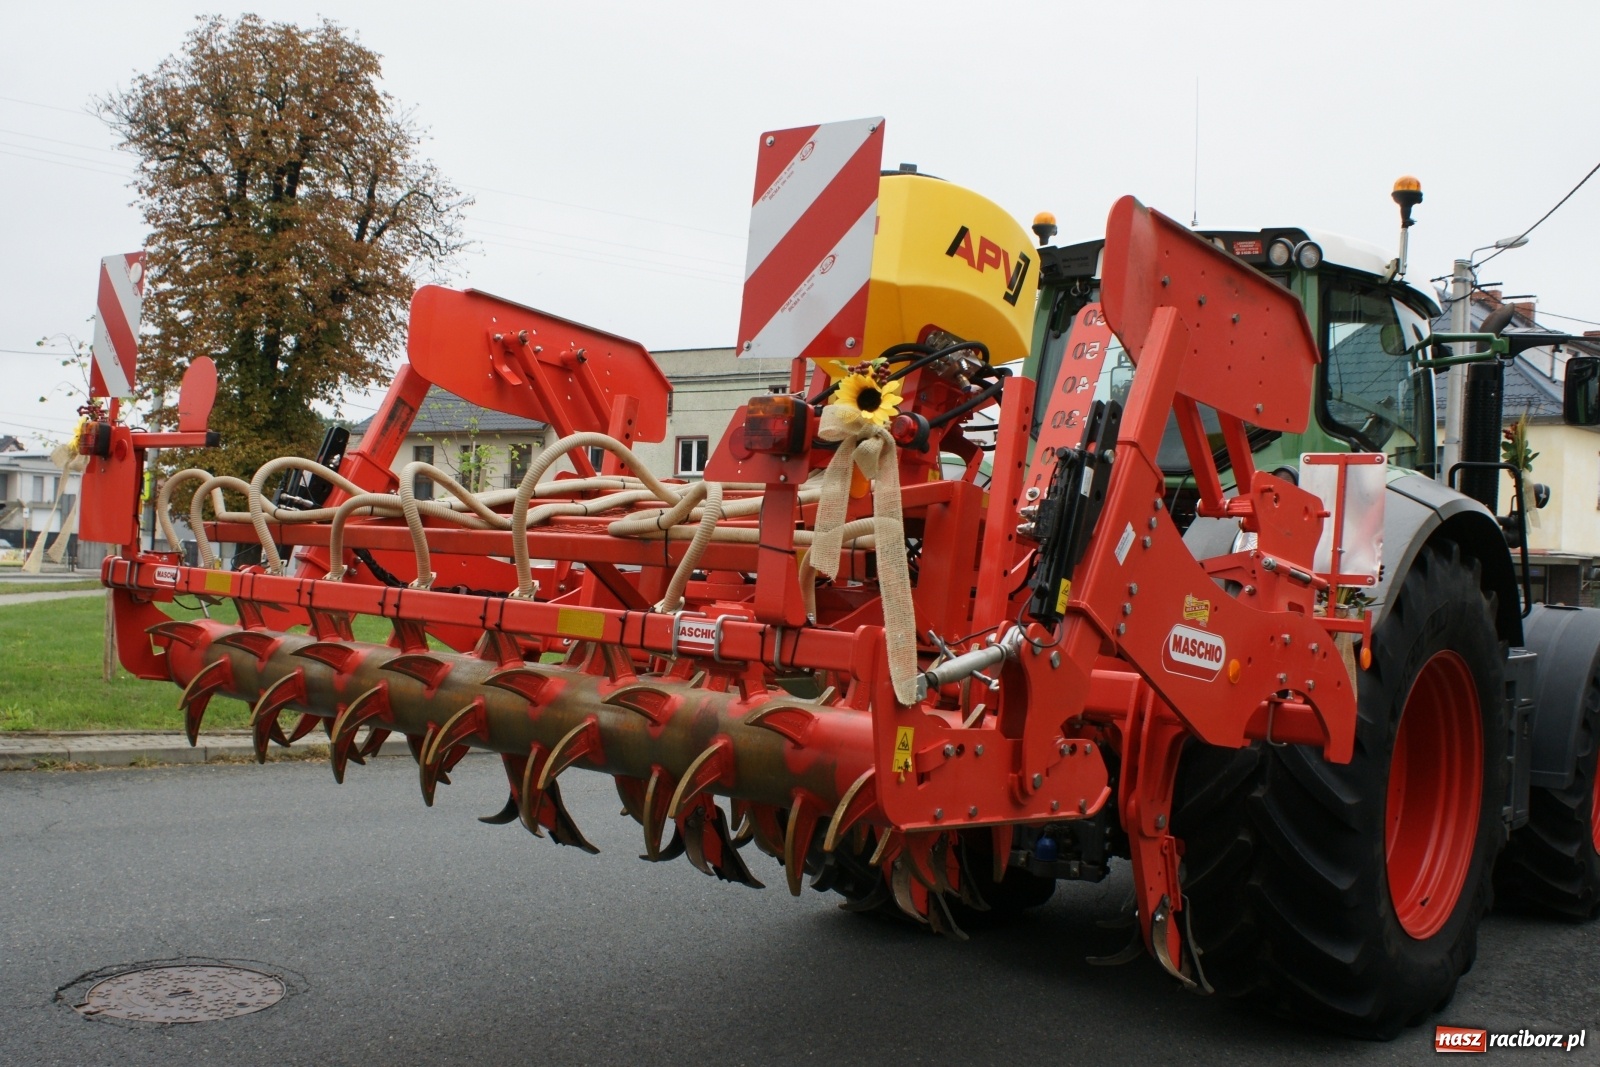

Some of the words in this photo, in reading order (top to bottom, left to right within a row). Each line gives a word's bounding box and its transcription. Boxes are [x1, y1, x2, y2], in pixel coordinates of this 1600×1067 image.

[945, 225, 1025, 297] APV
[678, 625, 716, 640] ASCHIO
[1172, 633, 1223, 664] MASCHIO
